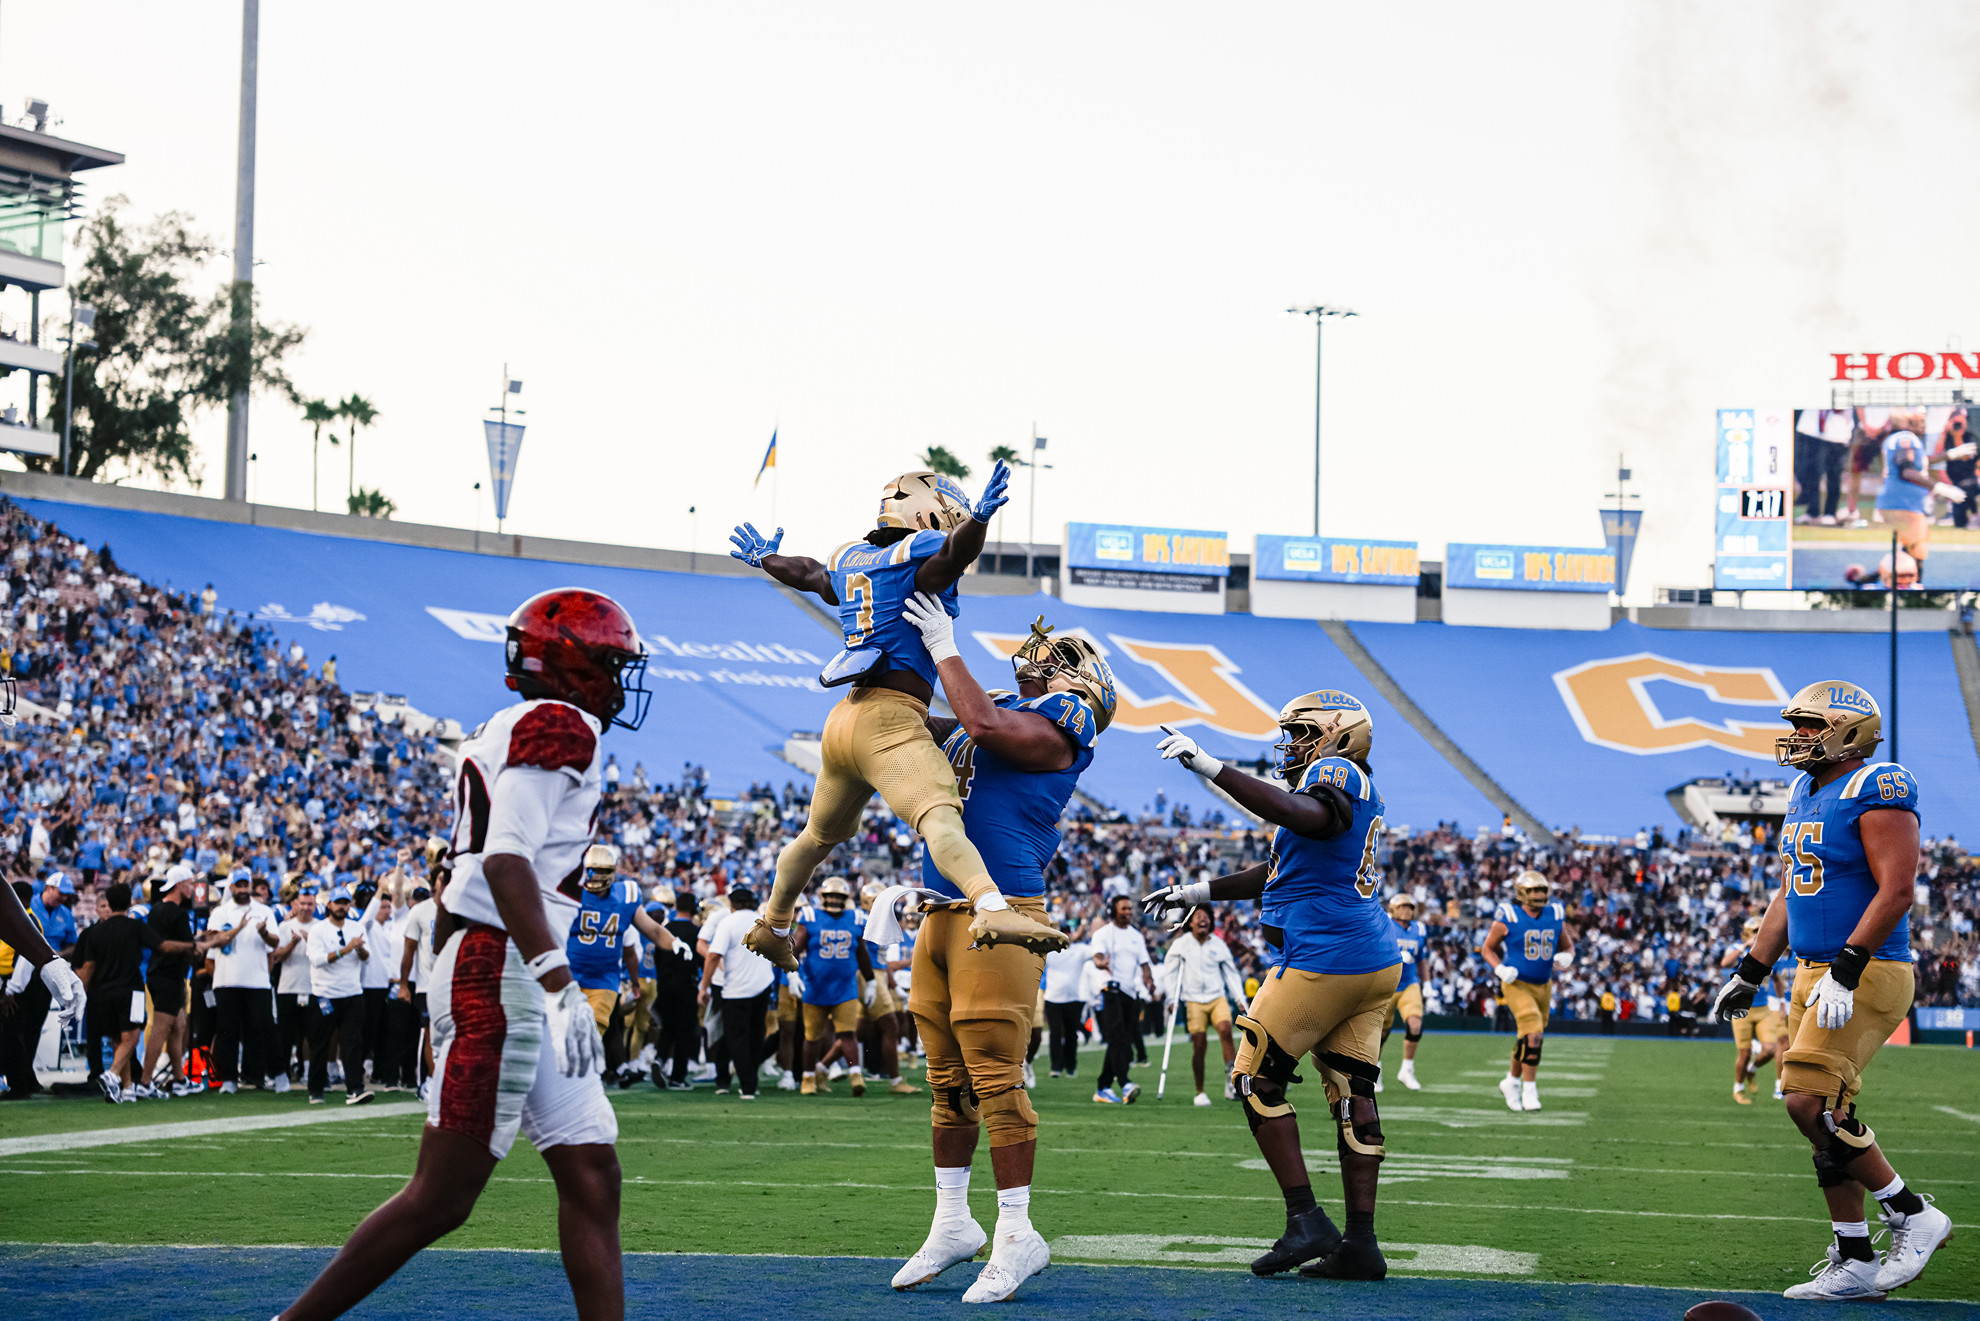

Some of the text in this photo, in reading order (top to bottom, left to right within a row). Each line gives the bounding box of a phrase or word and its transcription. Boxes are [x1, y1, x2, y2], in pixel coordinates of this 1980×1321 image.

[1831, 352, 1980, 381] HON
[1769, 446, 1778, 474] 3
[845, 571, 874, 648] 3
[641, 634, 825, 666] Health
[971, 626, 1793, 762] U C
[1315, 692, 1361, 711] Ucla
[1828, 687, 1874, 716] Ucla
[1057, 698, 1086, 734] 74
[1318, 765, 1349, 791] 68
[1876, 771, 1909, 801] 65
[1354, 815, 1383, 899] 6
[1778, 821, 1825, 897] 65
[577, 910, 620, 949] 54
[818, 929, 853, 960] 52
[1524, 929, 1555, 961] 66
